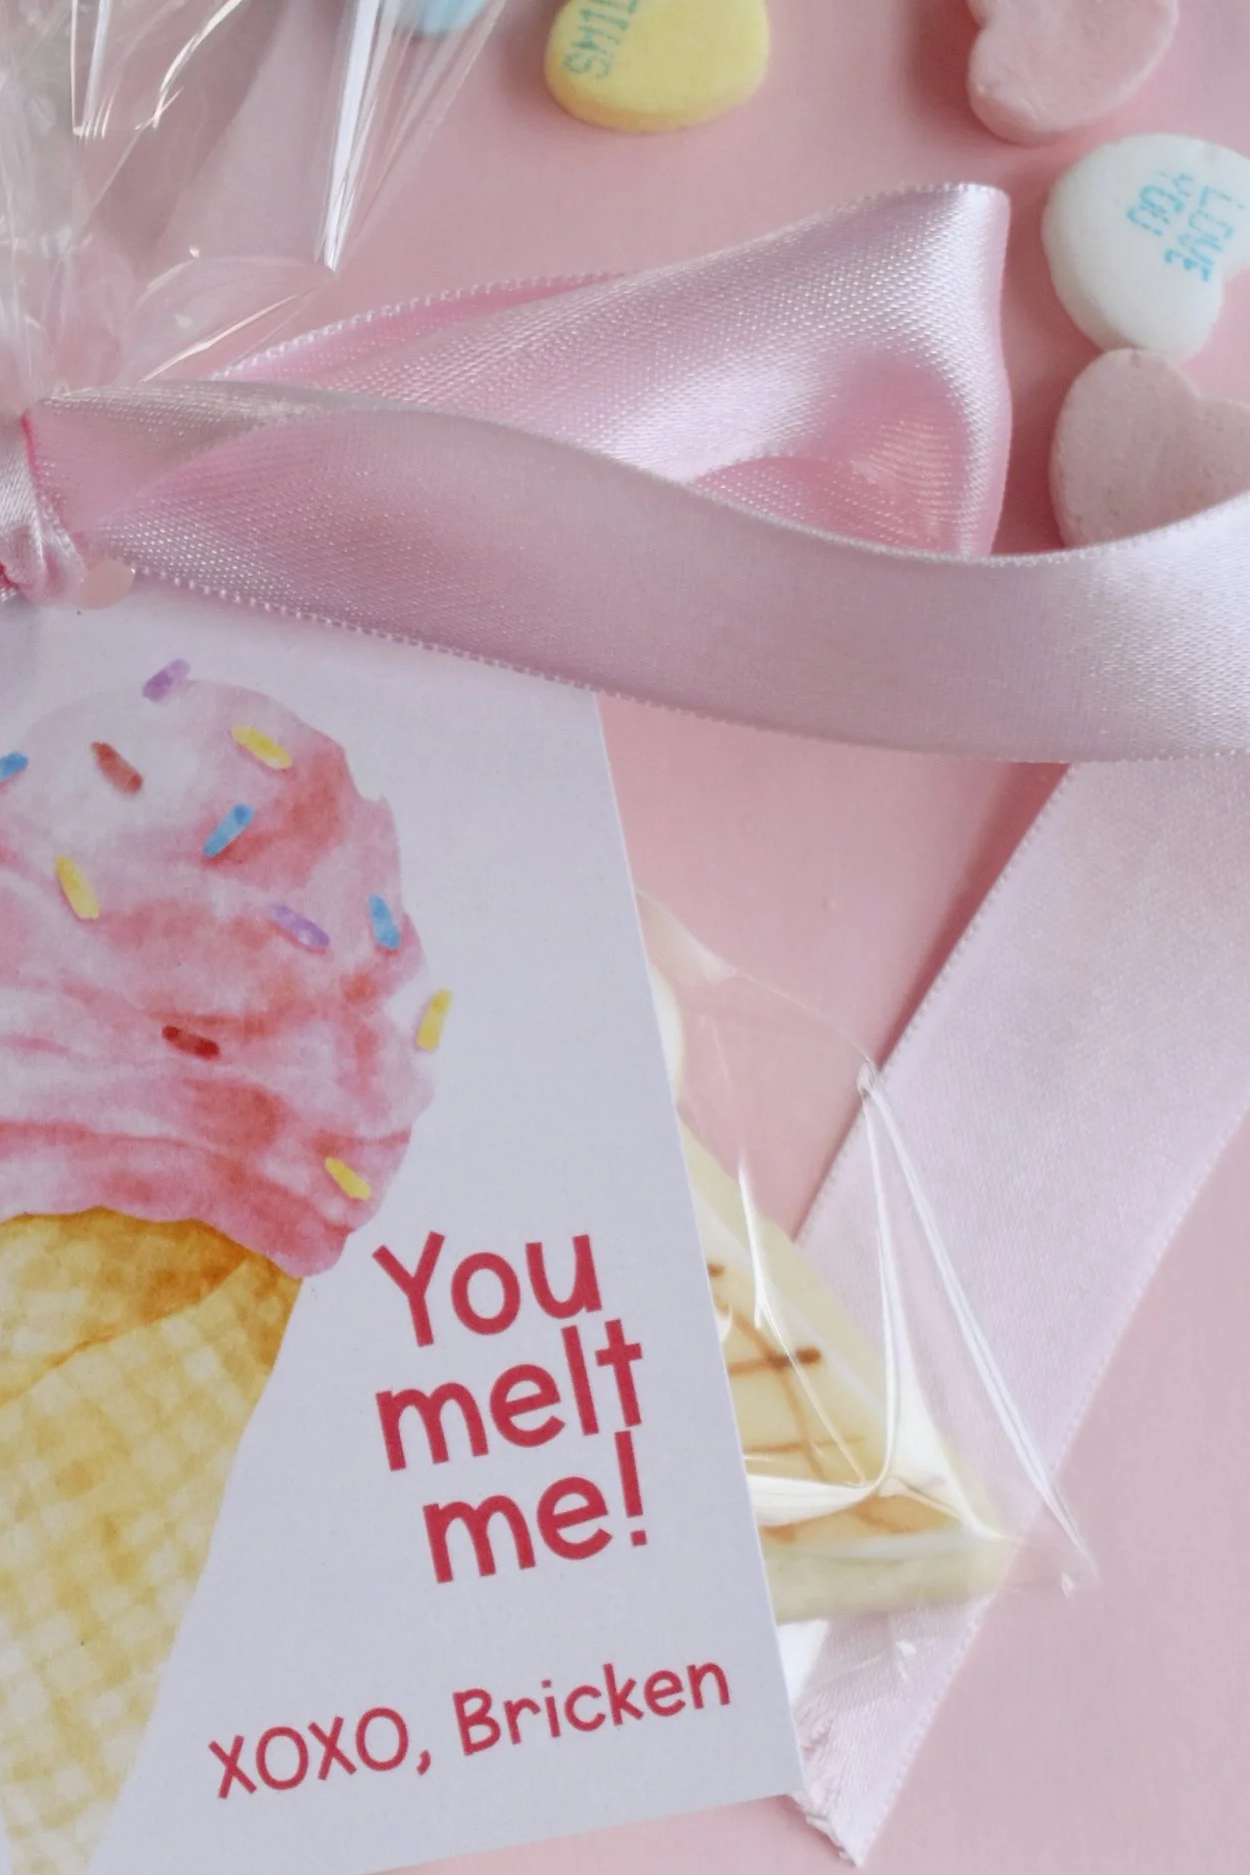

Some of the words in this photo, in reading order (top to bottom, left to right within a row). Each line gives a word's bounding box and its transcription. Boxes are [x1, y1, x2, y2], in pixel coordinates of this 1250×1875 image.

[1125, 170, 1194, 237] YOU
[1161, 184, 1247, 282] LOVE
[373, 1231, 603, 1347] You
[376, 1318, 643, 1471] melt
[423, 1429, 648, 1583] me!
[209, 1706, 432, 1799] XOXO,
[452, 1661, 731, 1755] Bricken
